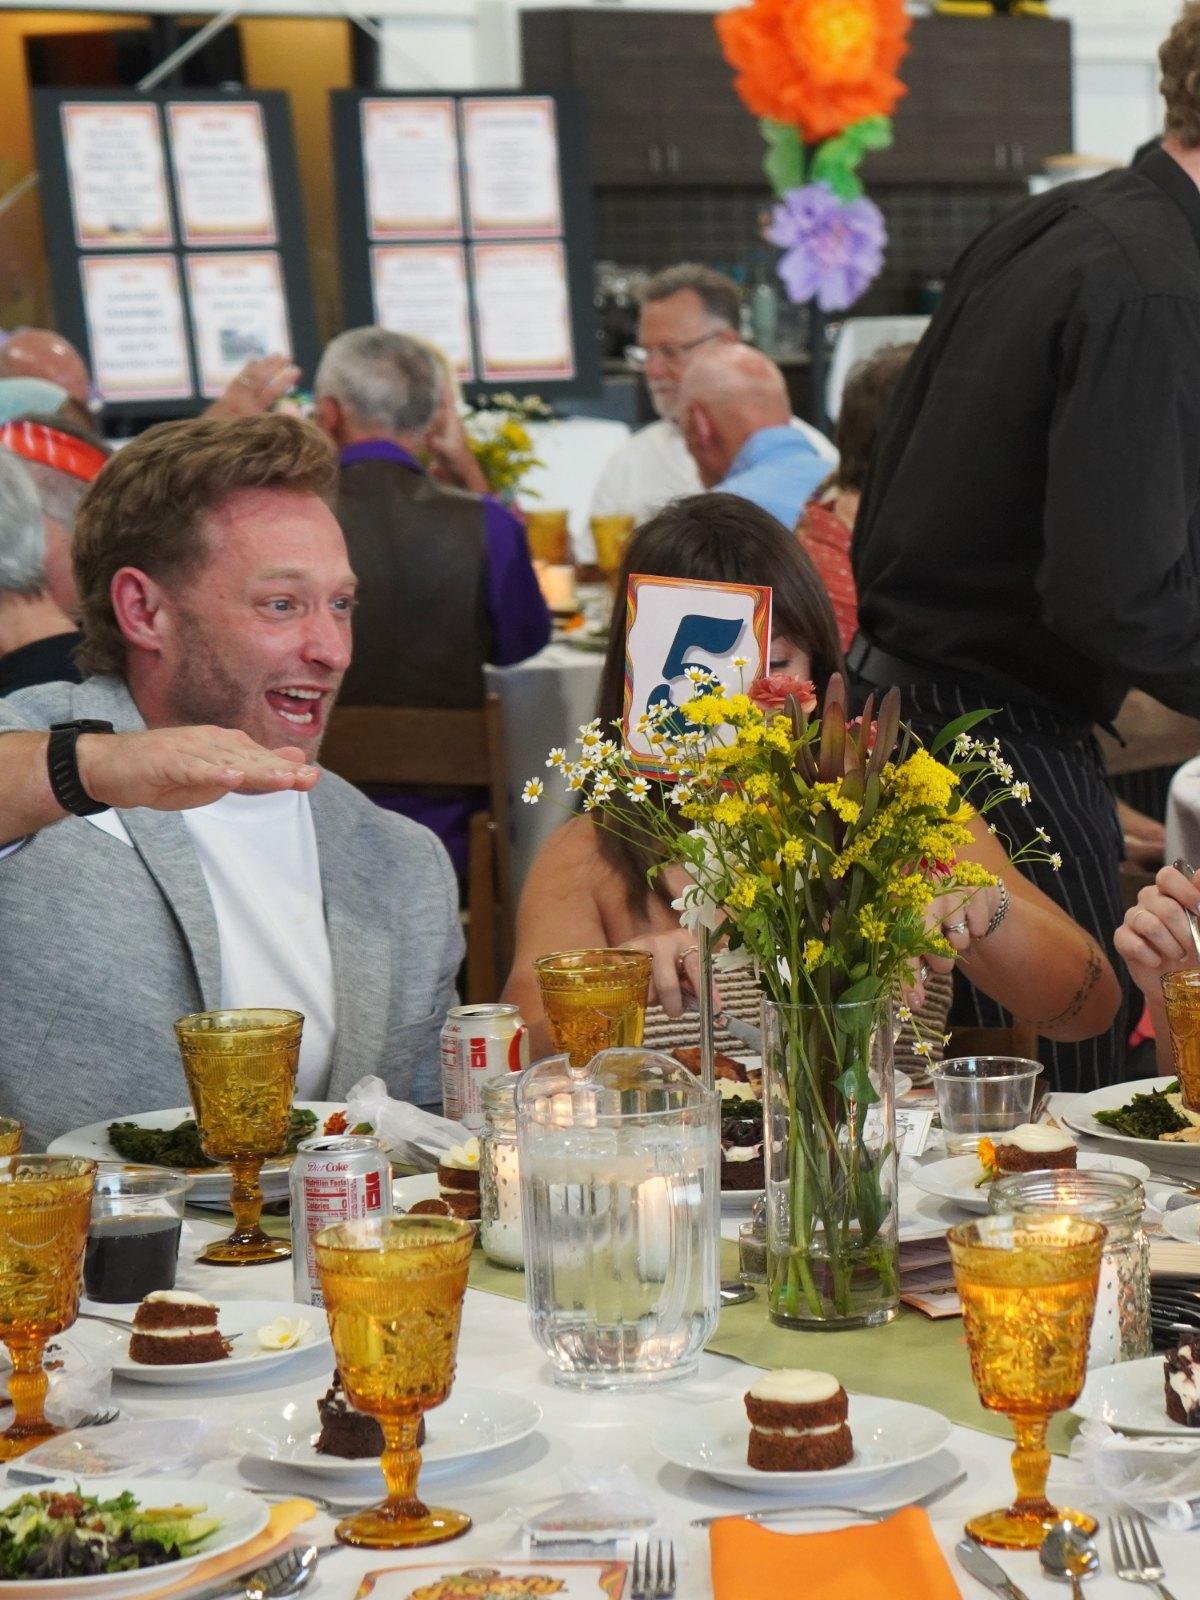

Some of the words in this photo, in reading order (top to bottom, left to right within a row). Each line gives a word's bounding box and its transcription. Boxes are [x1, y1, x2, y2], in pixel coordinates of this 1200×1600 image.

[646, 613, 745, 741] 5
[325, 1162, 349, 1172] Coke
[341, 1198, 348, 1209] 0
